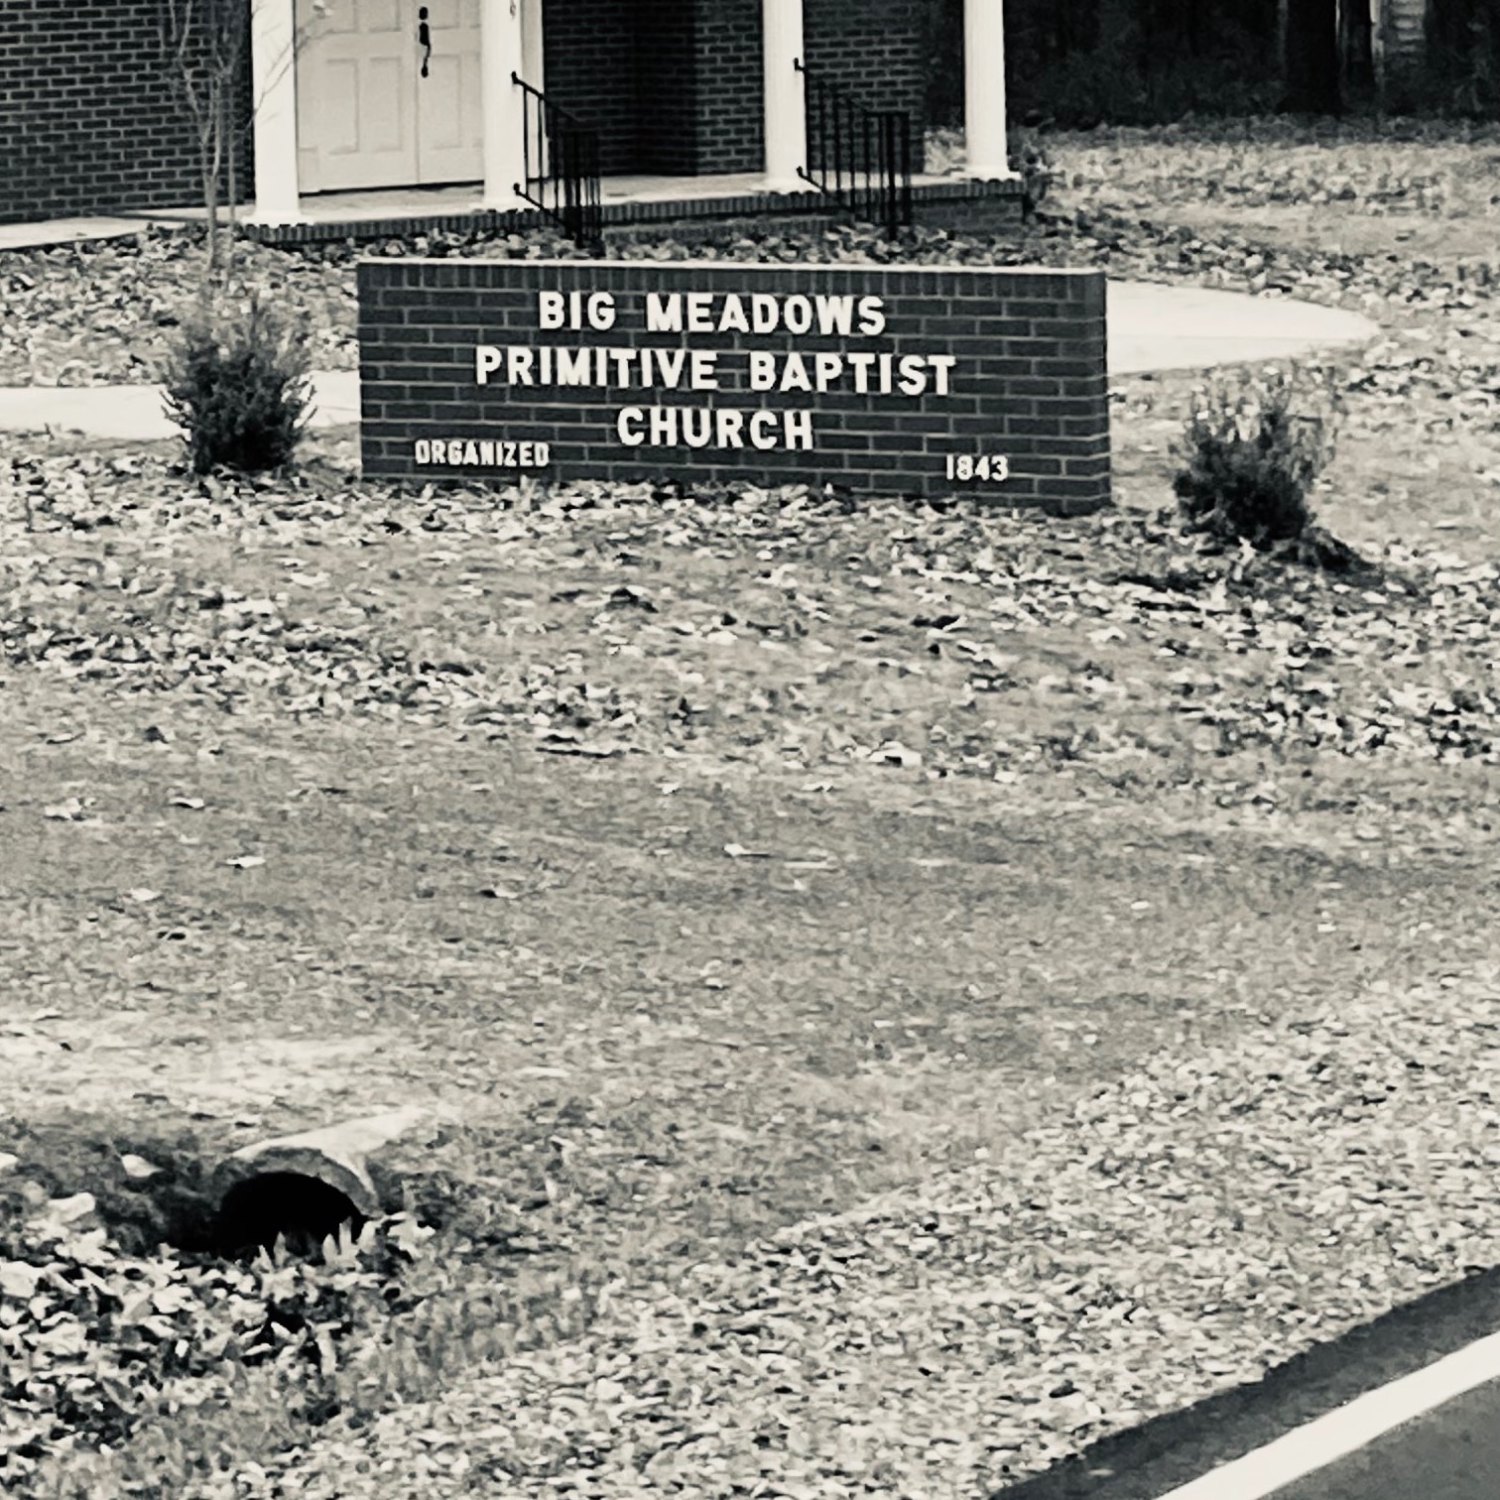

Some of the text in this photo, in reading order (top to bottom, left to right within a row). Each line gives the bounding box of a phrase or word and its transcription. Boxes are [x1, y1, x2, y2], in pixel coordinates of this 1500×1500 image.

[538, 289, 887, 337] BIG MEADOWS
[475, 344, 957, 397] PRIMITIVE BAPTIST
[616, 404, 814, 451] CHURCH
[414, 438, 551, 468] ORGANIZED
[945, 453, 1010, 482] 1843
